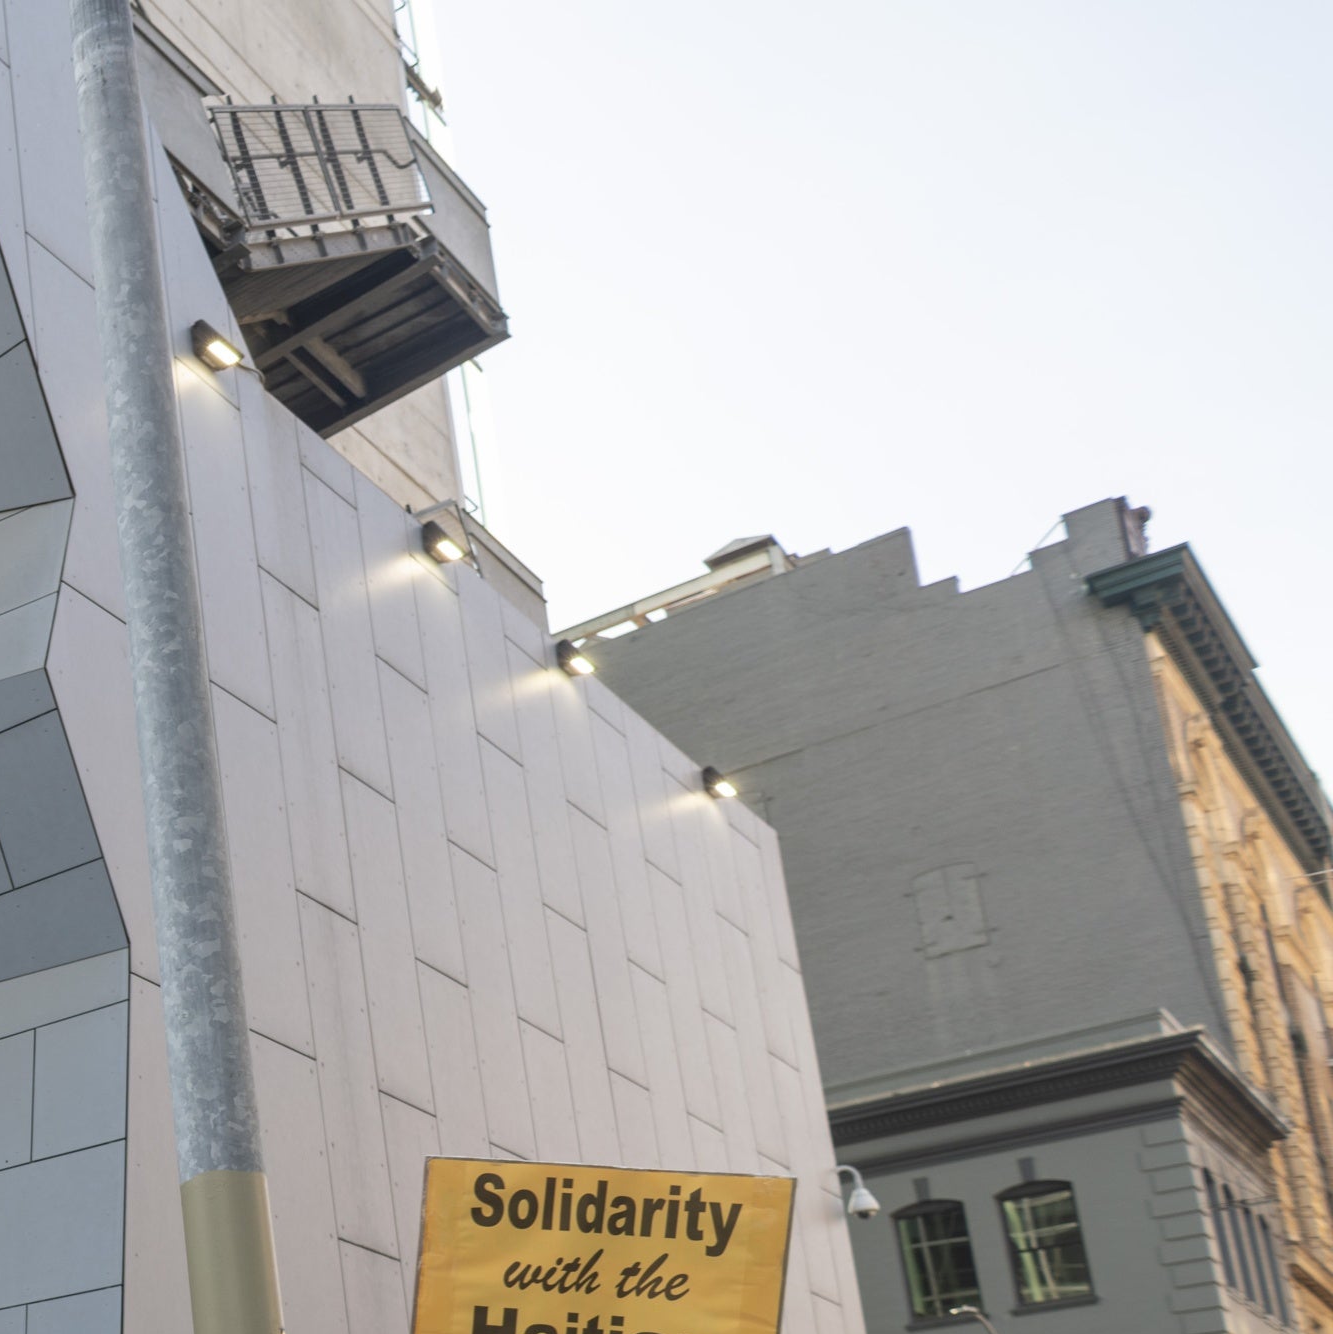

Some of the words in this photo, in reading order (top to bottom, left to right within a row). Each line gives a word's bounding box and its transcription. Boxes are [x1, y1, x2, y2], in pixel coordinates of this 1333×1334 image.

[470, 1171, 743, 1257] Solidarity
[502, 1248, 602, 1295] with
[615, 1252, 691, 1301] the
